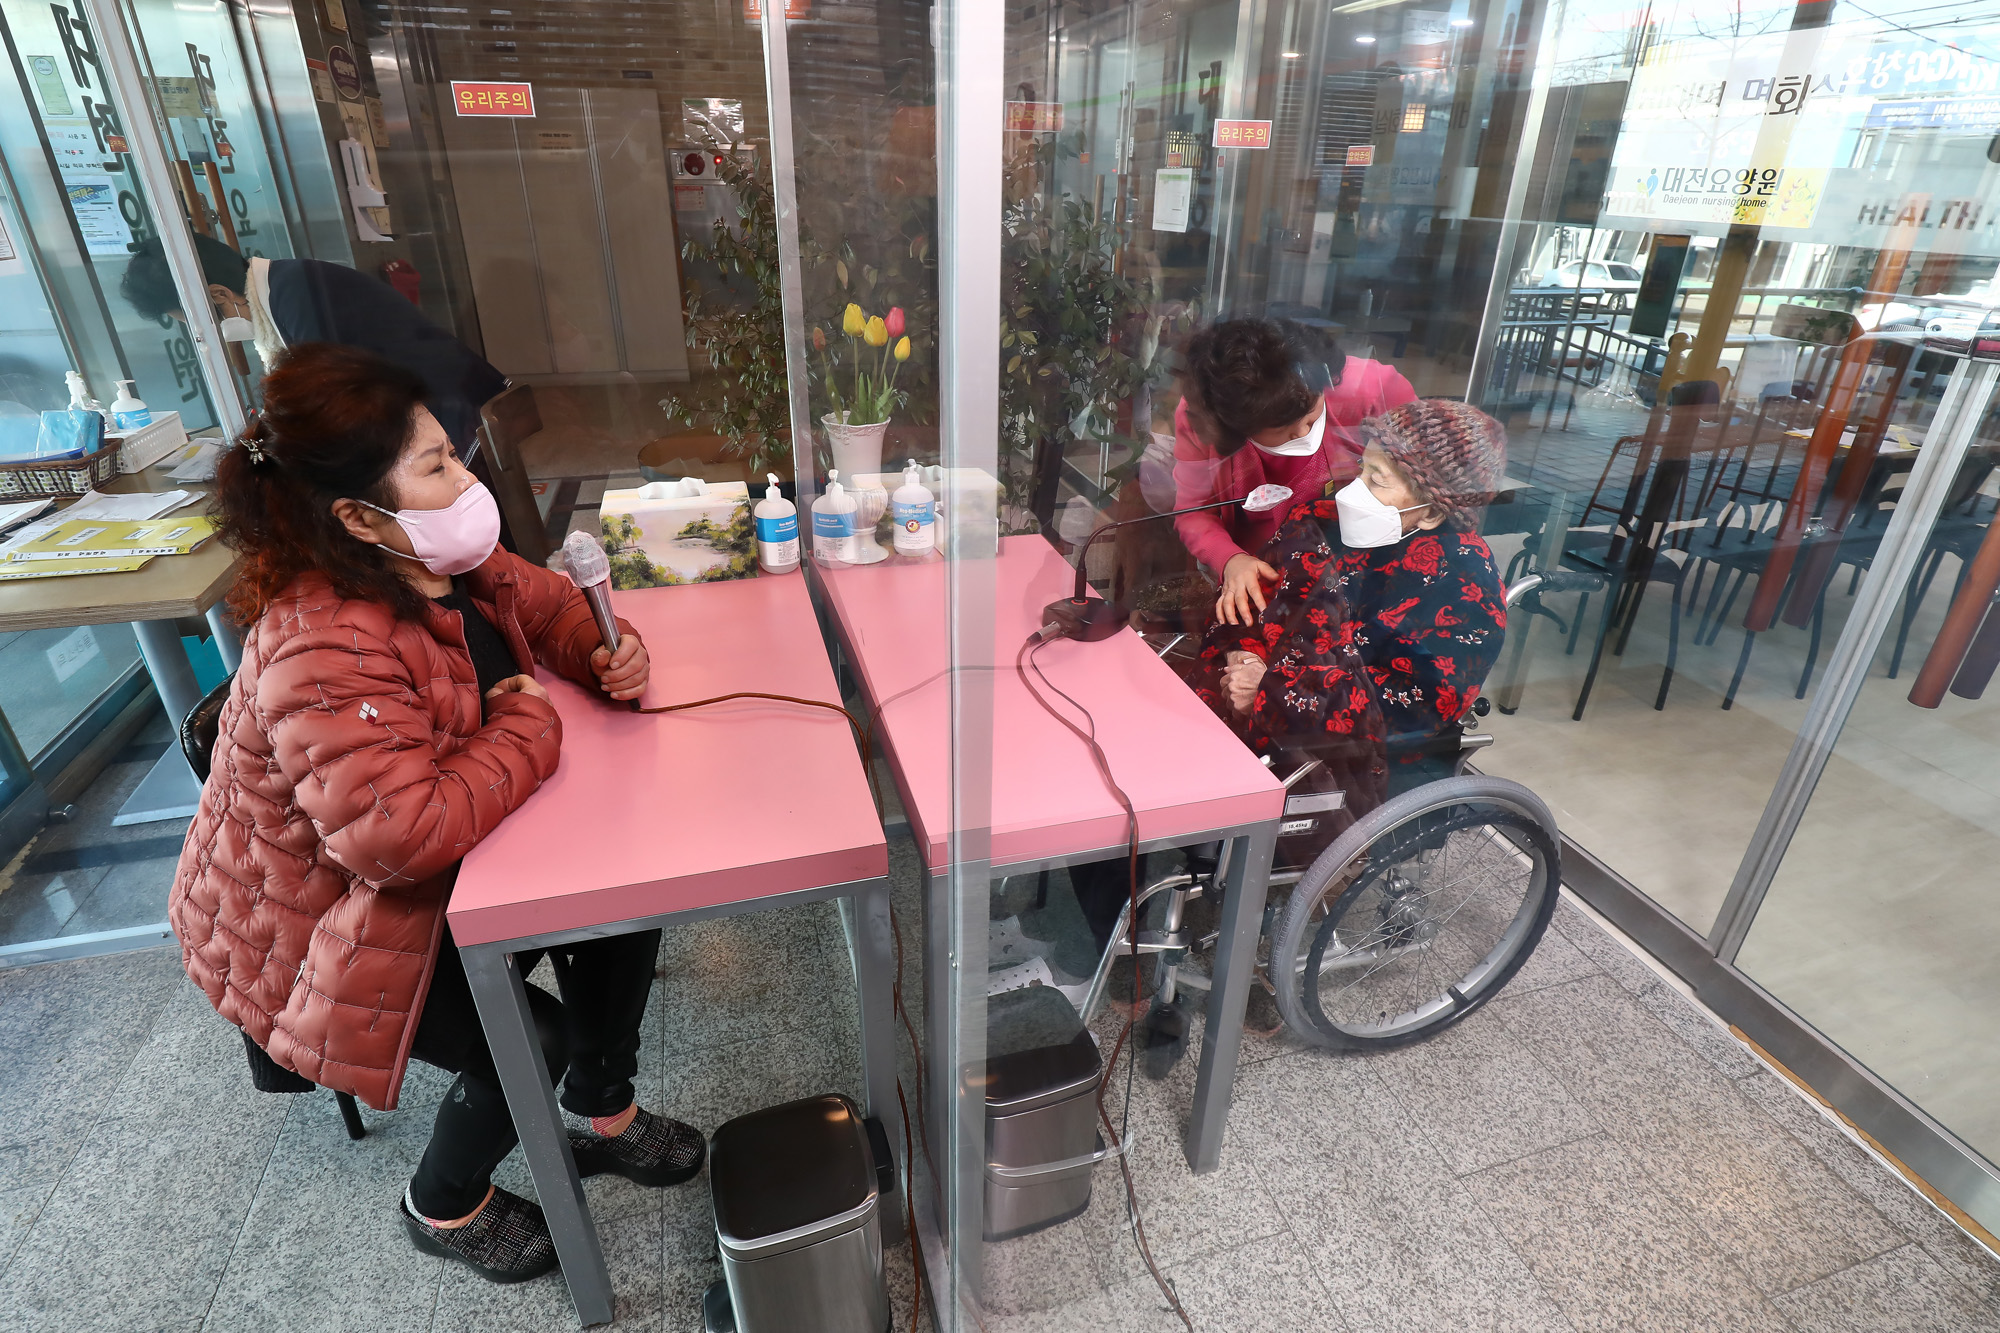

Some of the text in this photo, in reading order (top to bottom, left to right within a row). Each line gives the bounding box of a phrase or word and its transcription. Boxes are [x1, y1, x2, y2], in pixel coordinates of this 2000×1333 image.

[460, 91, 528, 110] 유리주의
[1219, 127, 1267, 142] 유리주의
[1661, 167, 1784, 195] 대전요양원
[1663, 194, 1767, 208] Daejeon nursing home
